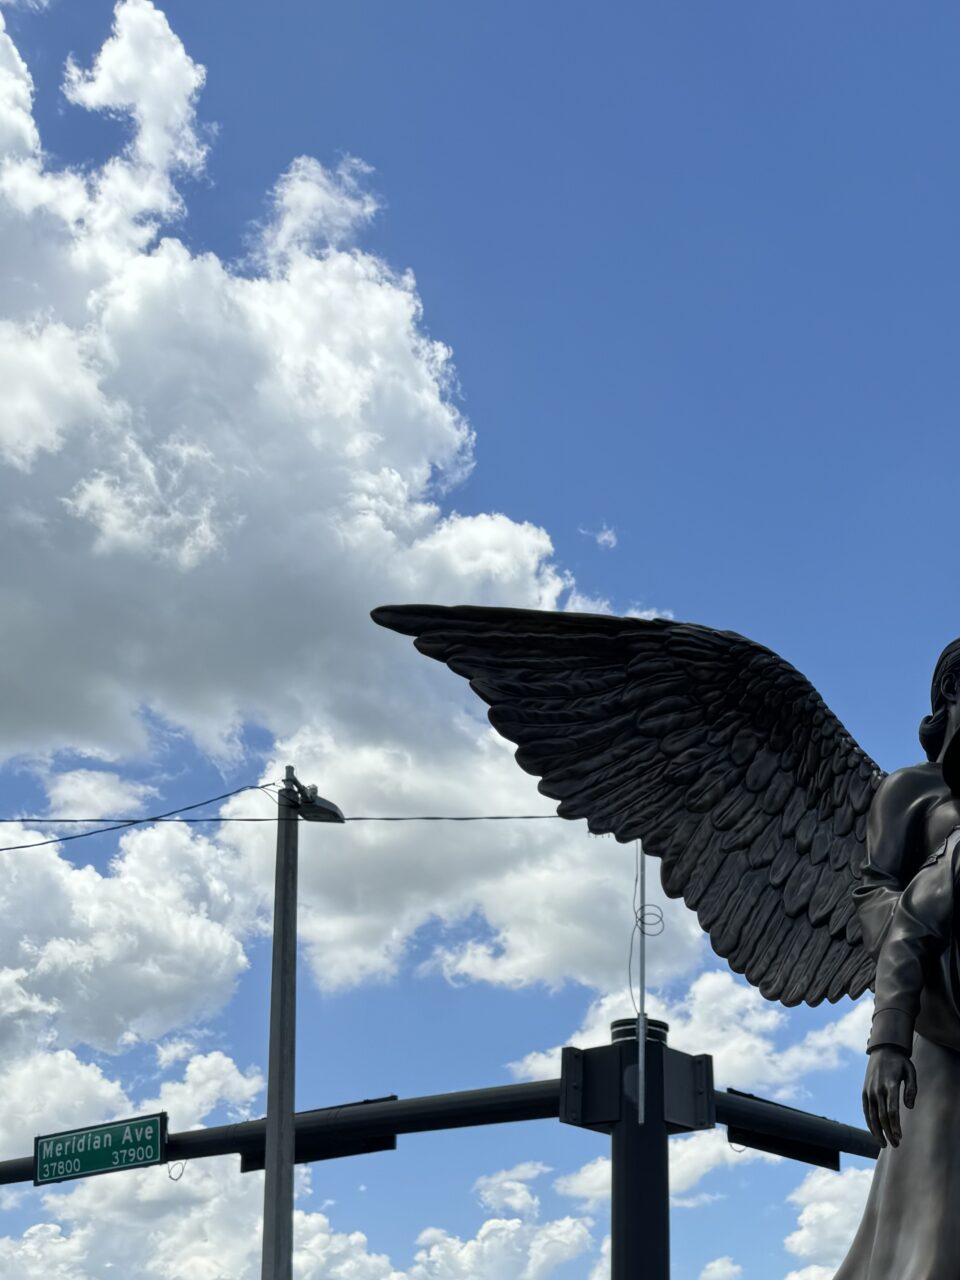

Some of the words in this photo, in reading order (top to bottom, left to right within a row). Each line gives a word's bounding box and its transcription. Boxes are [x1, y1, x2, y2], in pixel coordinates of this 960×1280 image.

[42, 1133, 112, 1159] Meridian
[122, 1125, 153, 1145] Ave
[43, 1158, 80, 1178] 37800
[112, 1145, 154, 1165] 37900
